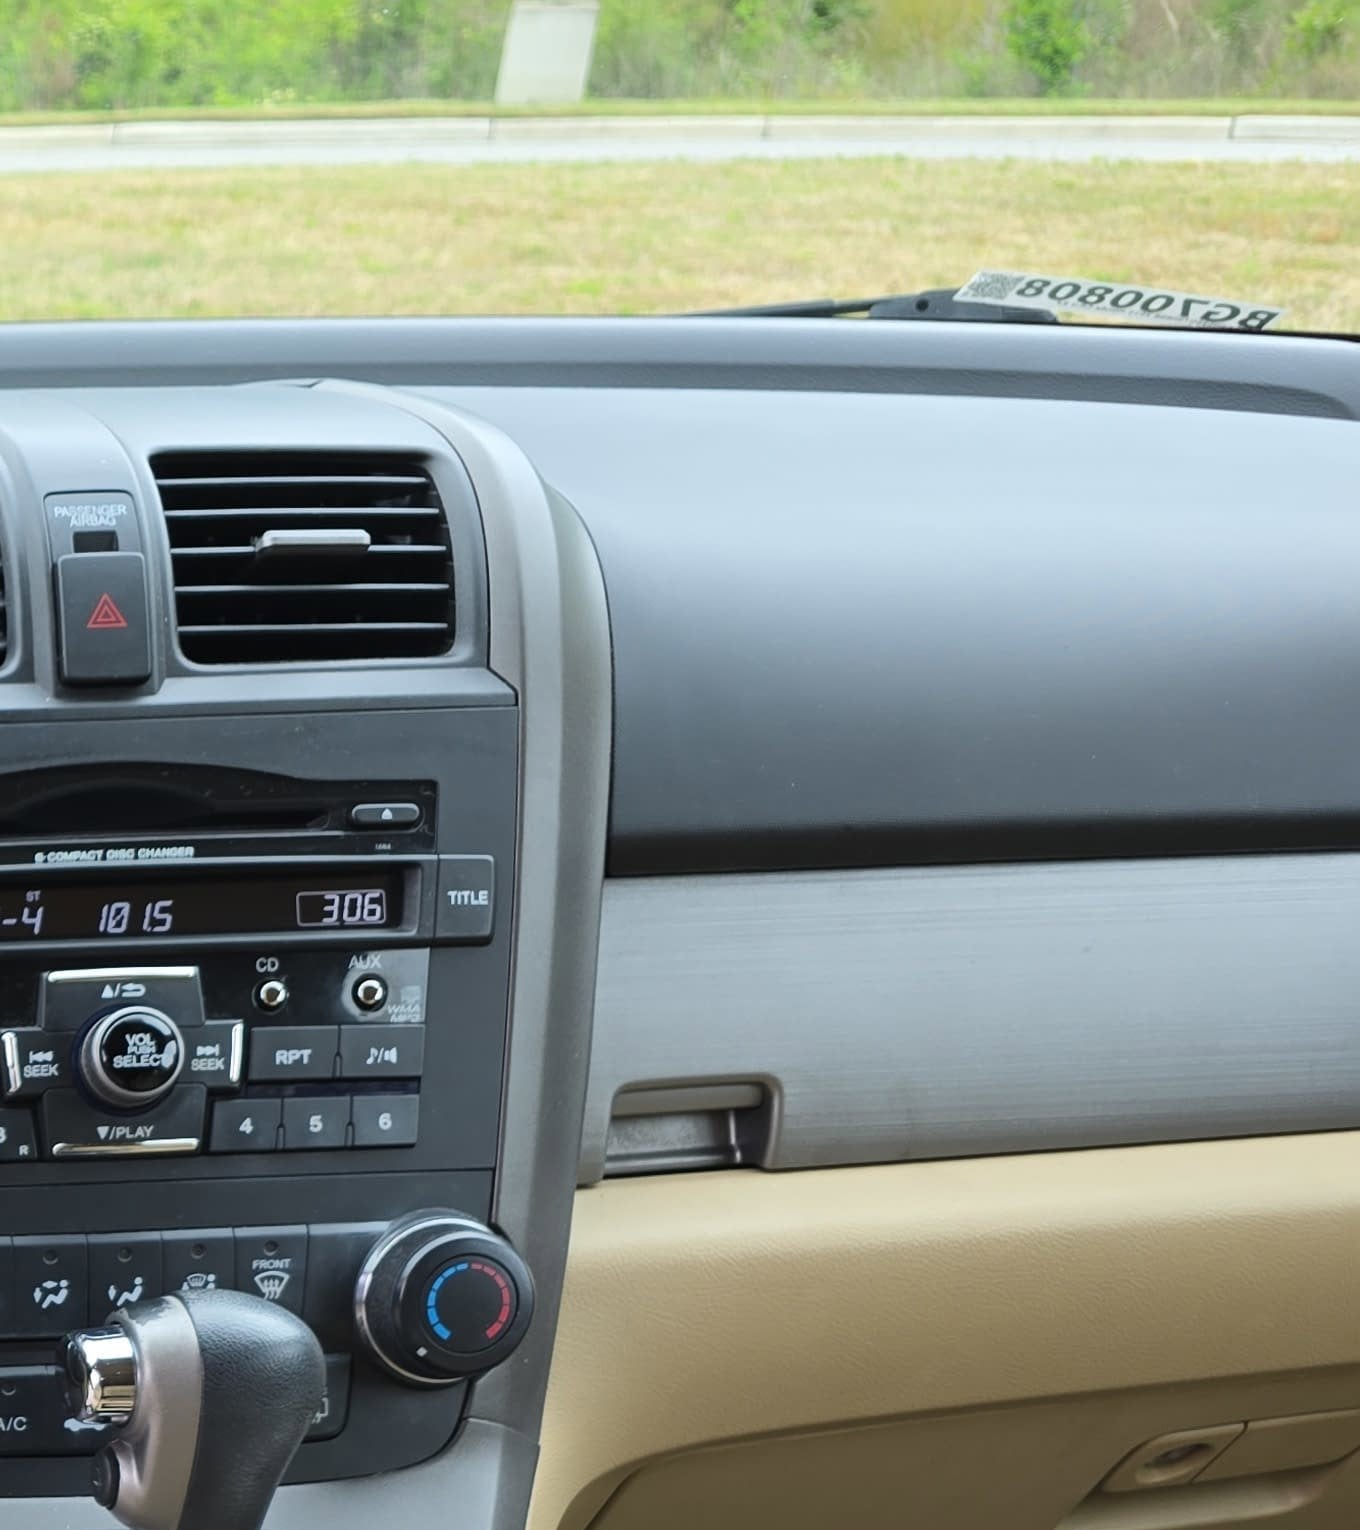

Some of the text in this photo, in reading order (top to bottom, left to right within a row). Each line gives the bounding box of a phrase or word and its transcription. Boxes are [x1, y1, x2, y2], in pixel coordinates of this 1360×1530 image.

[53, 504, 128, 518] PASSENGER
[69, 515, 116, 527] AIRBAG
[47, 850, 103, 862] COMPACT
[138, 846, 194, 858] CHANGER
[447, 890, 489, 906] TITLE
[255, 957, 279, 973] CD
[348, 954, 383, 969] AUX
[125, 1033, 155, 1046] VOL
[191, 1056, 224, 1071] SEEK
[275, 1049, 312, 1065] RPT
[23, 1064, 59, 1078] SEEK
[239, 1118, 254, 1134] 4
[309, 1116, 323, 1132] 5
[378, 1113, 392, 1130] 6
[19, 1145, 29, 1156] R
[252, 1258, 291, 1271] FRONT
